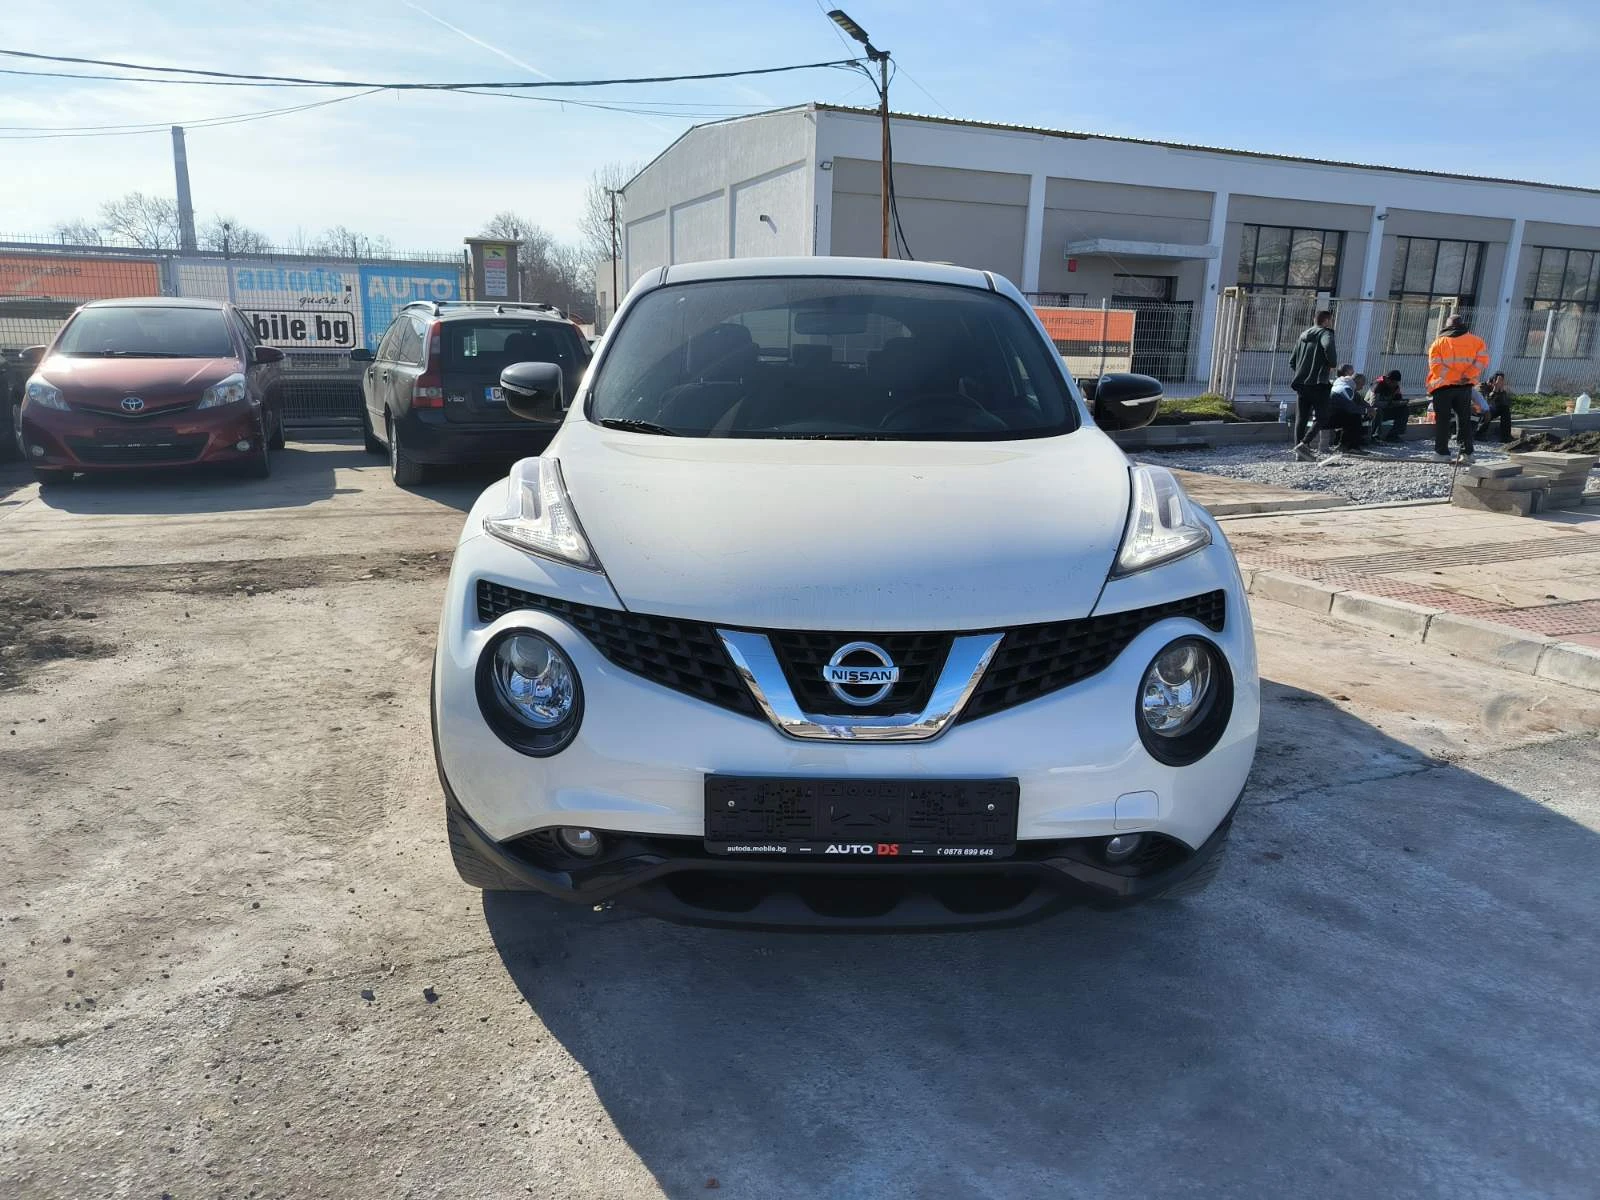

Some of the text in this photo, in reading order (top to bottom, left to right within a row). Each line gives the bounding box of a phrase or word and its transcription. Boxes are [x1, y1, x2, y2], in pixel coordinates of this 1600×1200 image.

[367, 275, 453, 300] AUTO
[831, 669, 892, 681] NISSAN
[727, 845, 787, 853] autods.mobile.bg
[824, 844, 873, 854] AUTO
[877, 844, 899, 855] DS
[979, 848, 994, 856] 645
